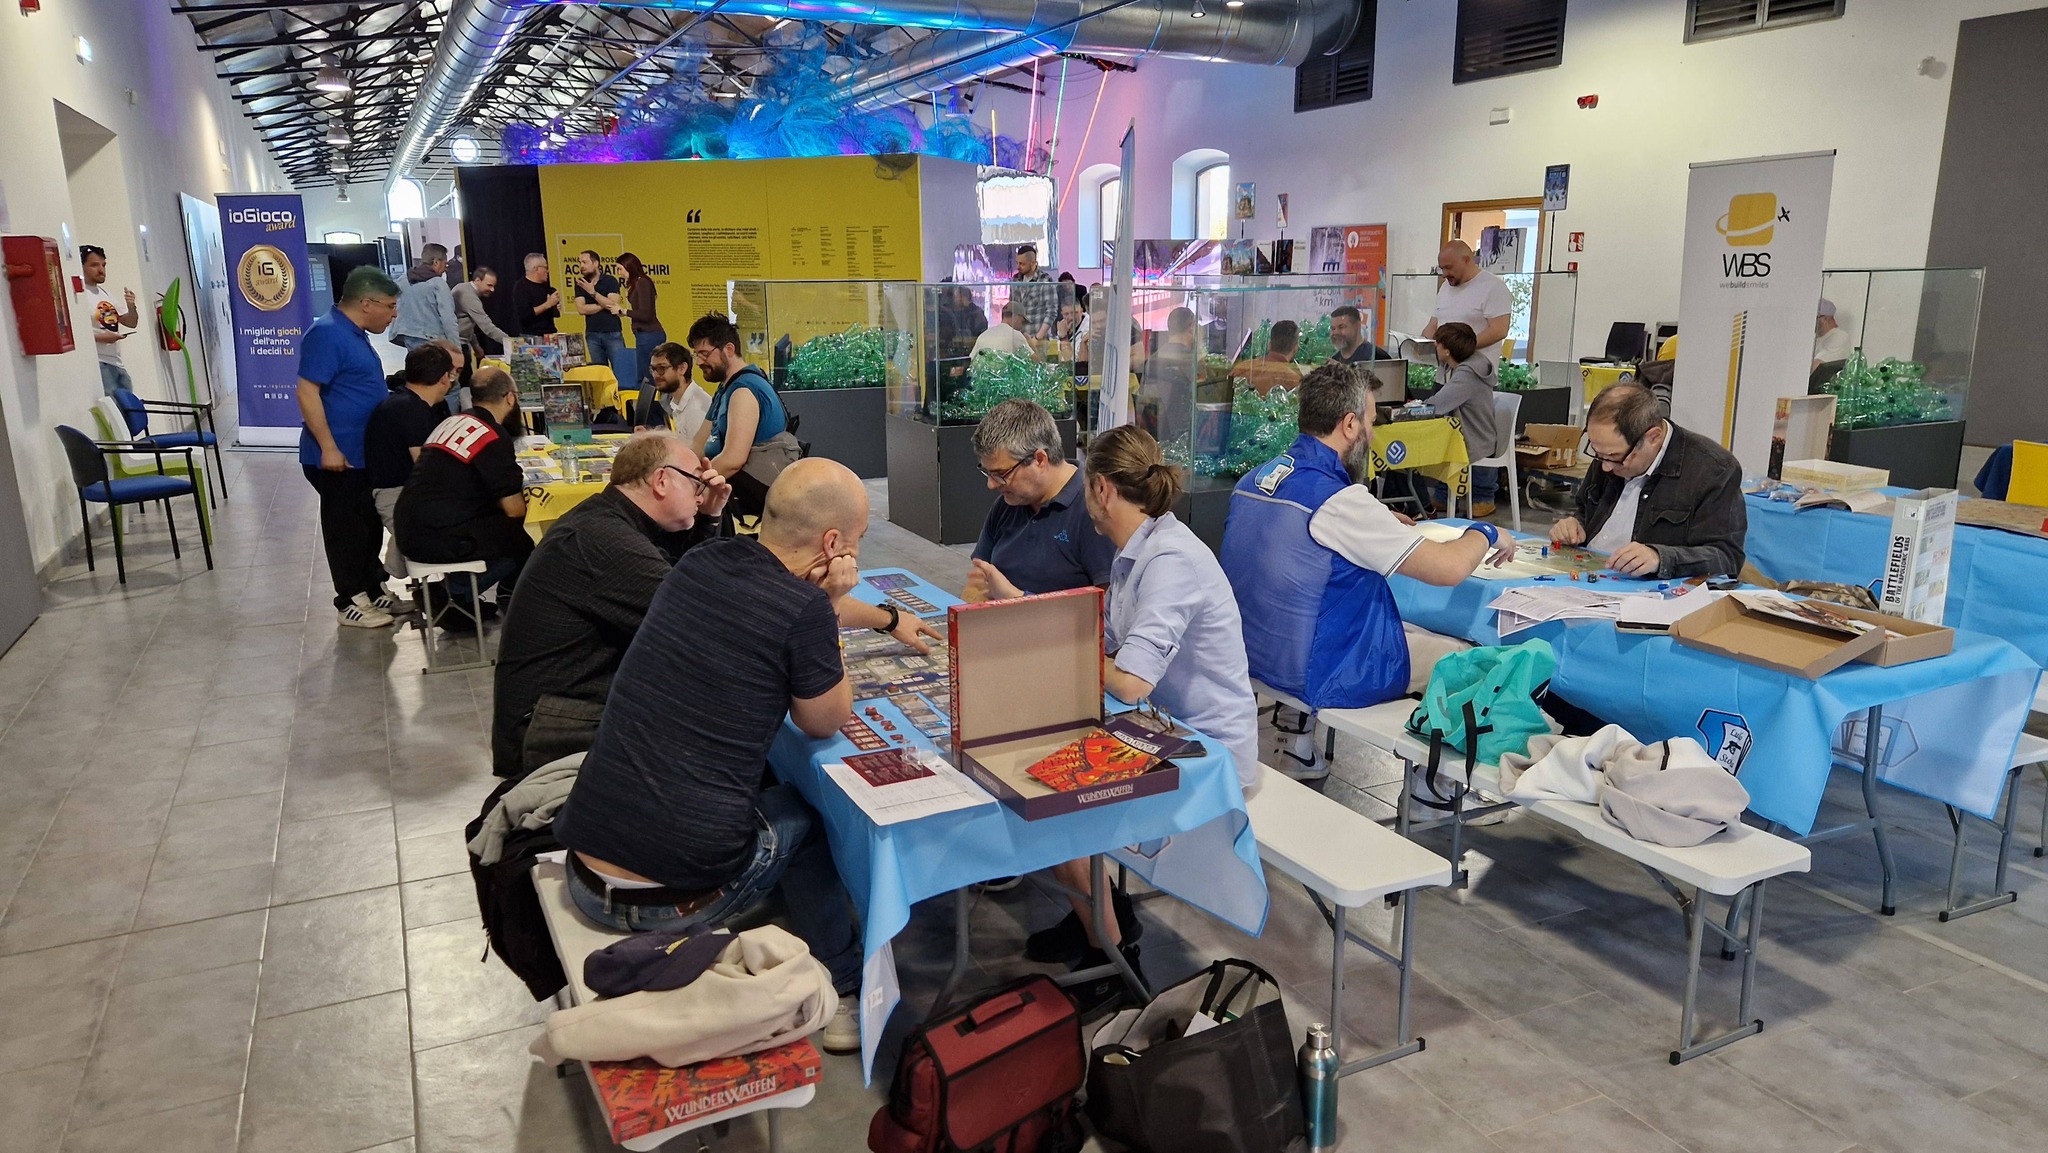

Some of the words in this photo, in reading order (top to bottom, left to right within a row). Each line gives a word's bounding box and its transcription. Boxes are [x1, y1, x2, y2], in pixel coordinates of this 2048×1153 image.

[229, 208, 292, 223] ioGioco
[266, 215, 296, 232] award
[1722, 252, 1771, 277] WBS
[244, 326, 275, 337] migliori
[277, 326, 302, 337] giochi
[257, 347, 282, 355] decidi
[1885, 535, 1905, 603] BATTLEFIELDS
[664, 1075, 777, 1123] WUNDERWAFFEN
